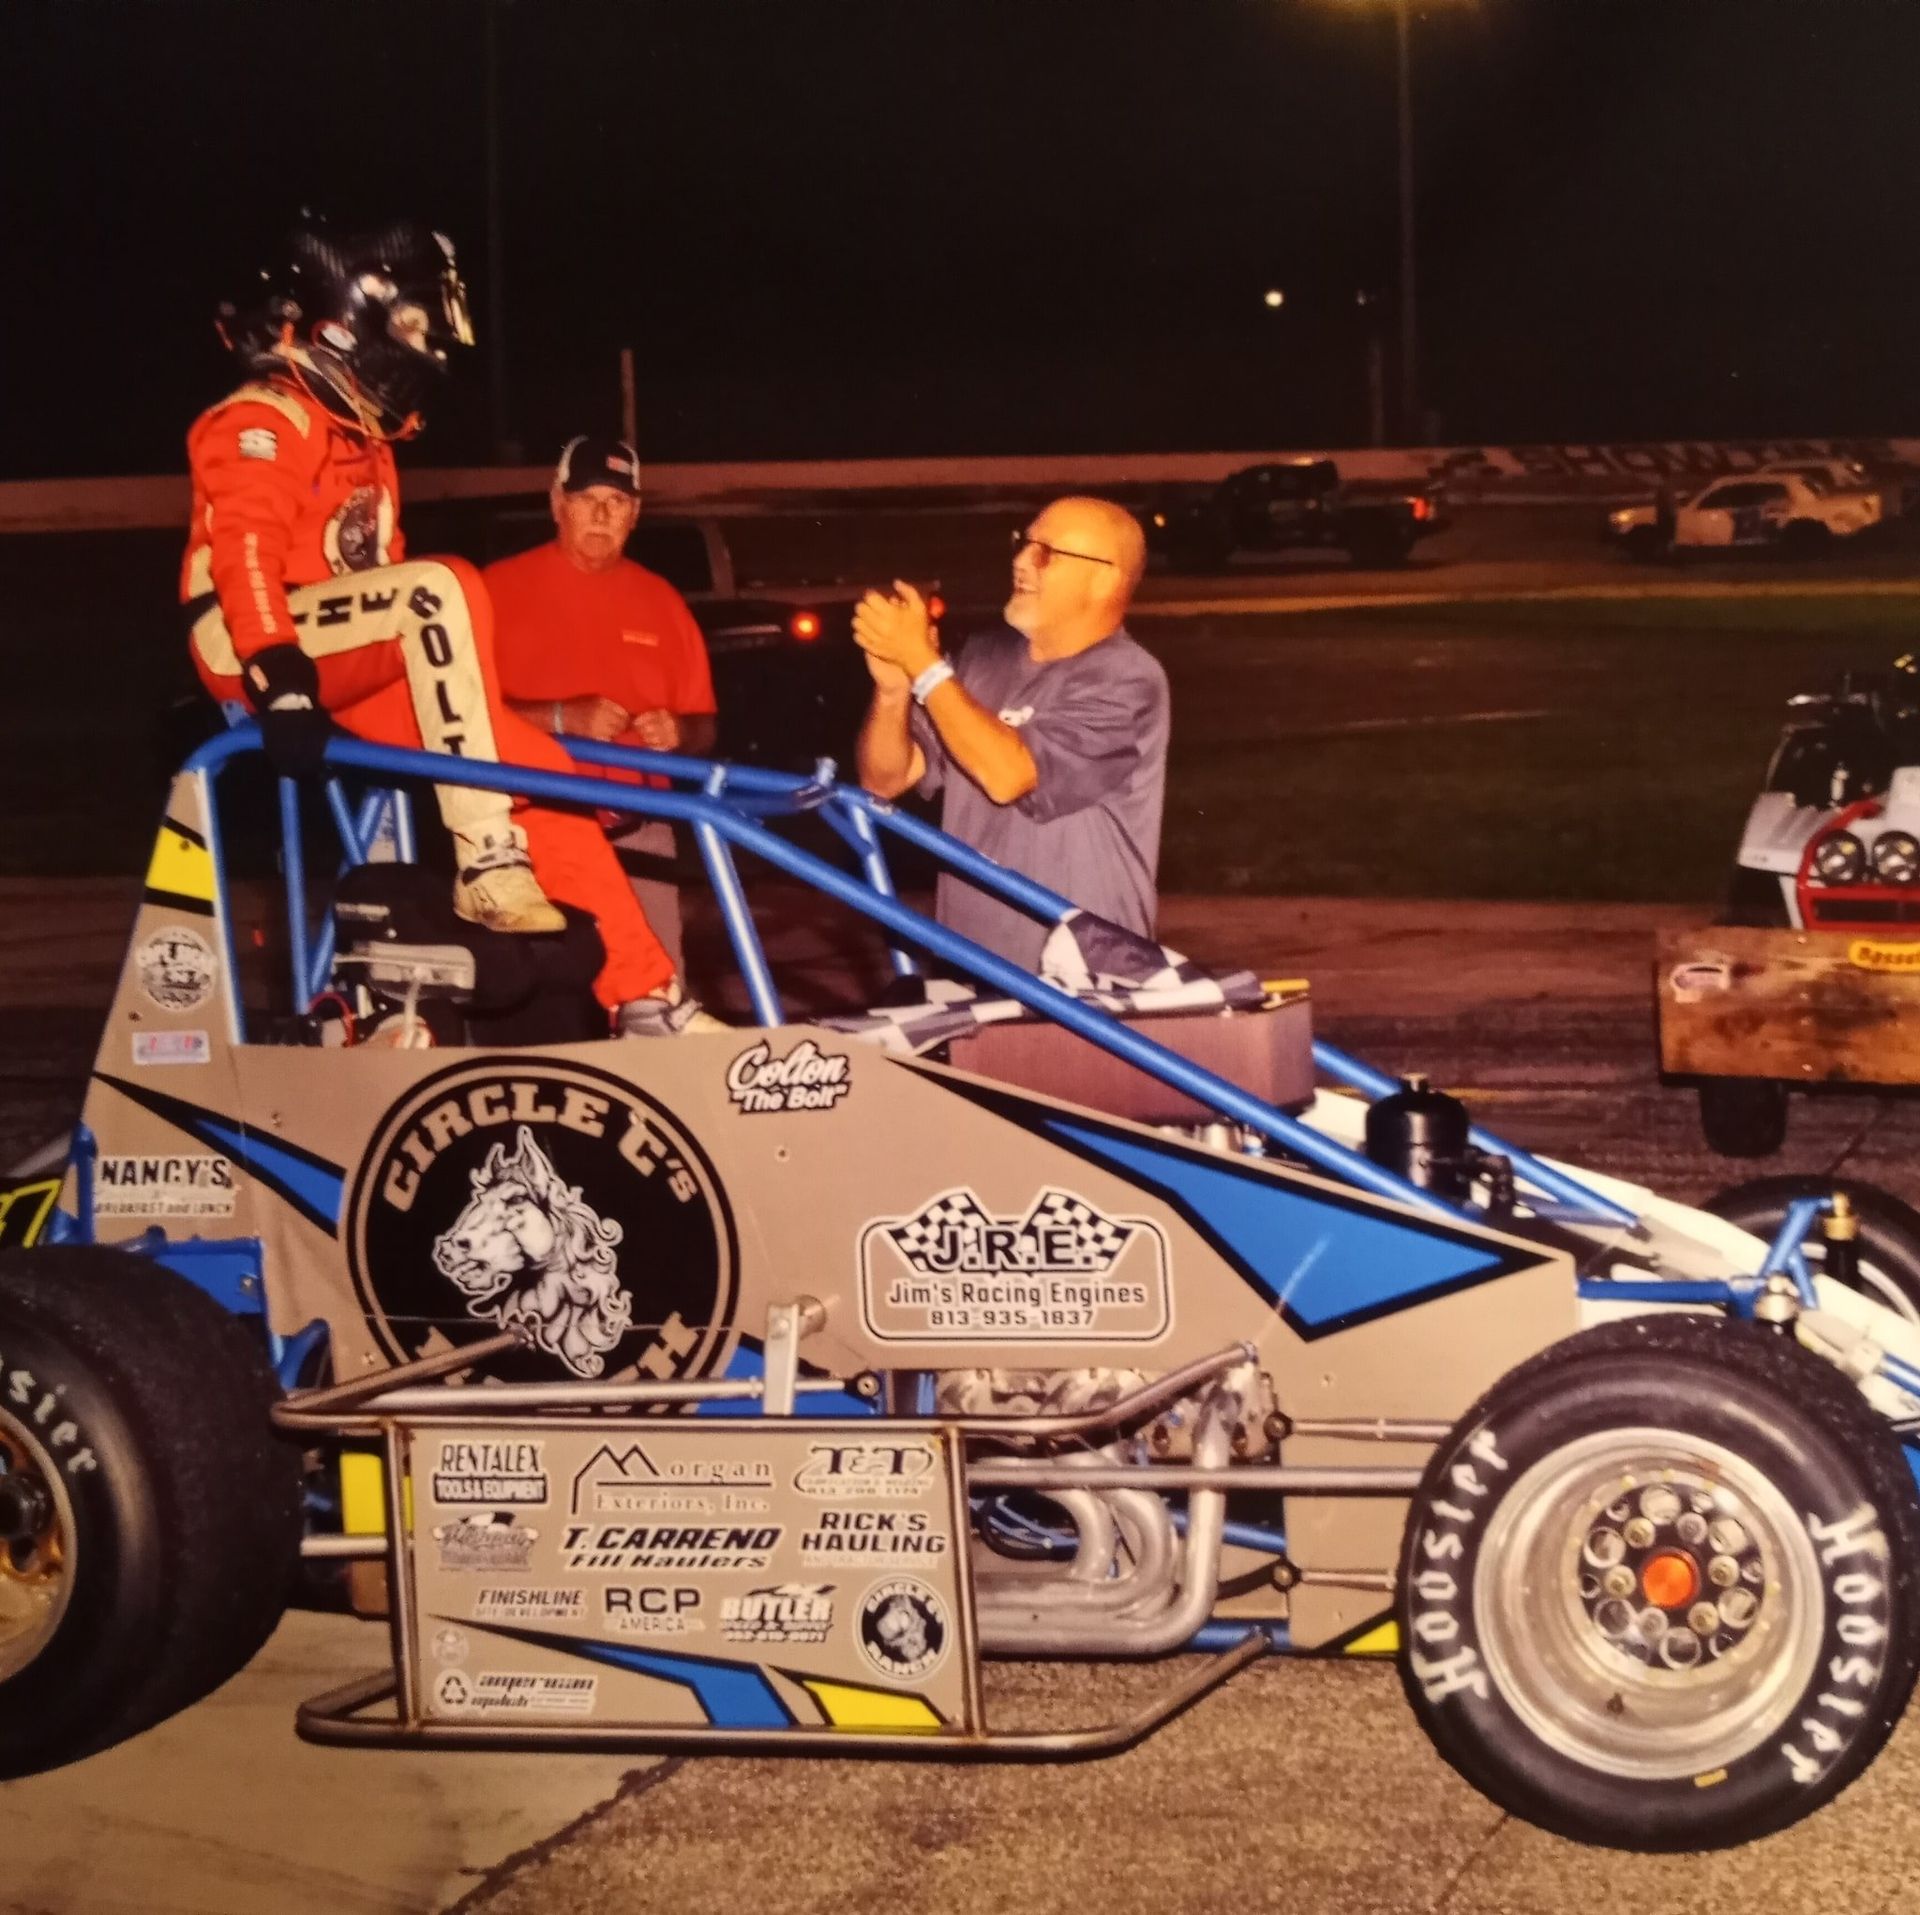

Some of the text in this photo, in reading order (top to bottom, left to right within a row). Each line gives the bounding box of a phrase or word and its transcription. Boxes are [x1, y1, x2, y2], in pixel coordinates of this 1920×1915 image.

[726, 1038, 849, 1089] Colton
[383, 1082, 610, 1212] CIRCLE
[101, 1159, 231, 1186] NANCY'S
[890, 1282, 1145, 1309] Jim's Racing Engines
[0, 1355, 97, 1473] sier
[441, 1444, 540, 1473] RENTALEX
[820, 1512, 928, 1532] RICK'S
[596, 1527, 782, 1550] CARRENO
[802, 1533, 946, 1554] HAULING
[630, 1554, 766, 1569] Haulers
[478, 1589, 583, 1605] FINISHLINE
[605, 1587, 700, 1614] RCP
[719, 1597, 834, 1621] BUTLER
[619, 1618, 685, 1631] AMERICA
